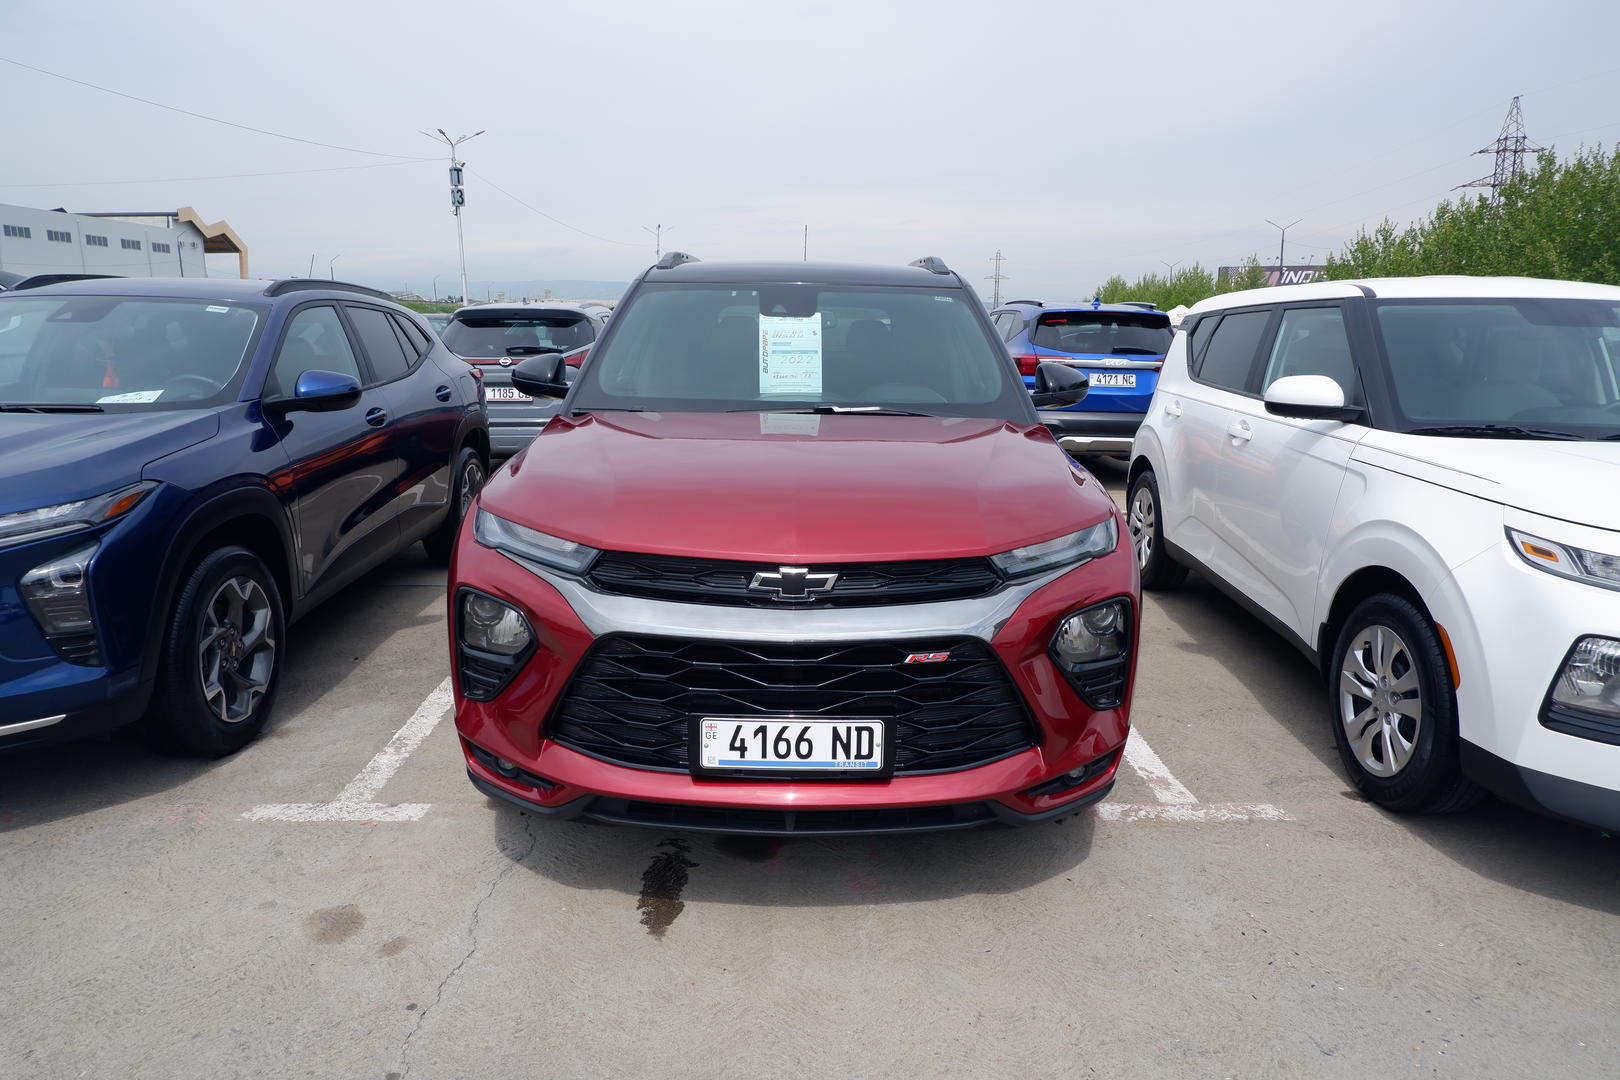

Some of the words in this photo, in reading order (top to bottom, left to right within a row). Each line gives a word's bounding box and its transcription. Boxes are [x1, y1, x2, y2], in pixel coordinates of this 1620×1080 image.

[1096, 374, 1118, 384] 4171
[1122, 374, 1134, 385] NC
[491, 388, 514, 399] 1185
[904, 652, 950, 663] RS
[705, 731, 717, 740] GE
[729, 724, 814, 760] 4166
[831, 726, 875, 760] ND
